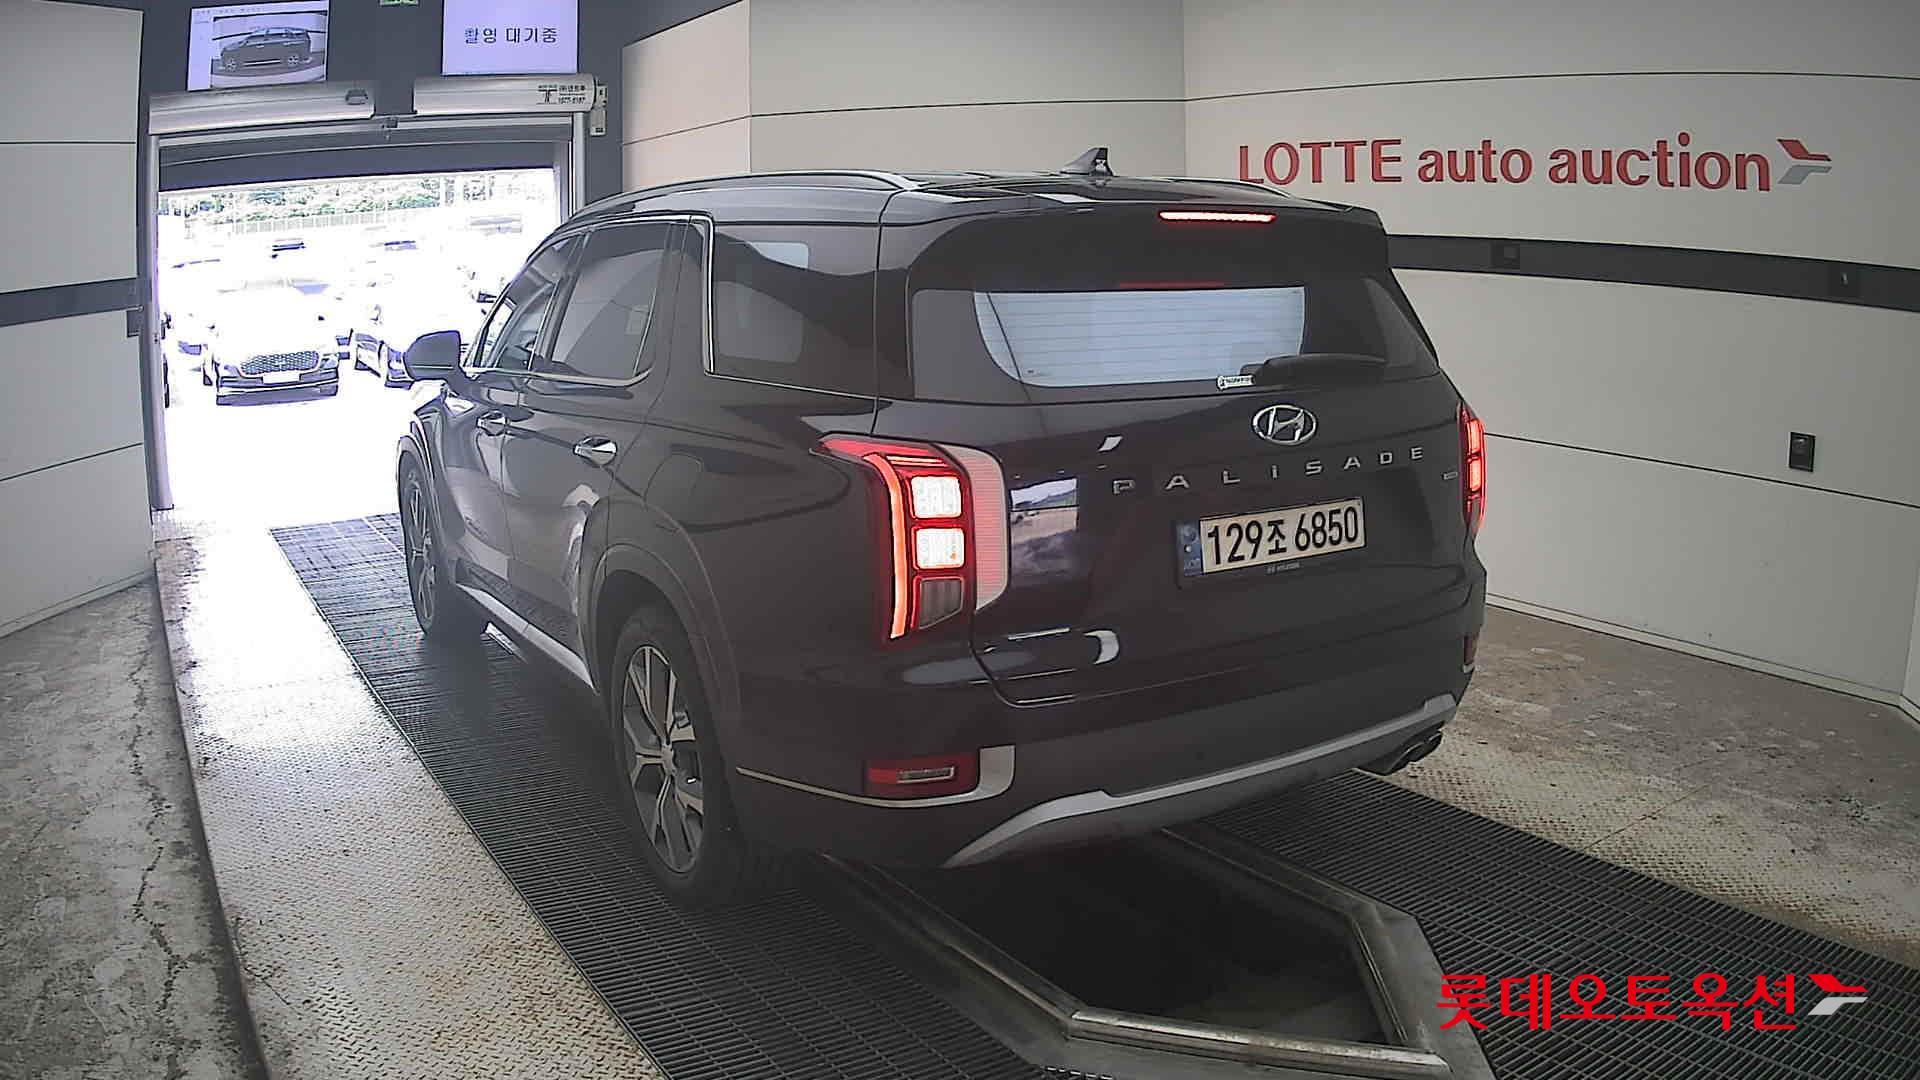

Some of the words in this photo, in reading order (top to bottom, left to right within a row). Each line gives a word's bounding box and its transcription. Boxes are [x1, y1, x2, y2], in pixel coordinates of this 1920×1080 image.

[505, 27, 558, 44] 대기중
[1239, 138, 1402, 186] LOTTE
[1417, 139, 1534, 184] auto
[1548, 131, 1771, 192] auction
[1112, 446, 1424, 495] PALISADE
[1207, 518, 1288, 565] 129조
[1294, 506, 1359, 552] 6850
